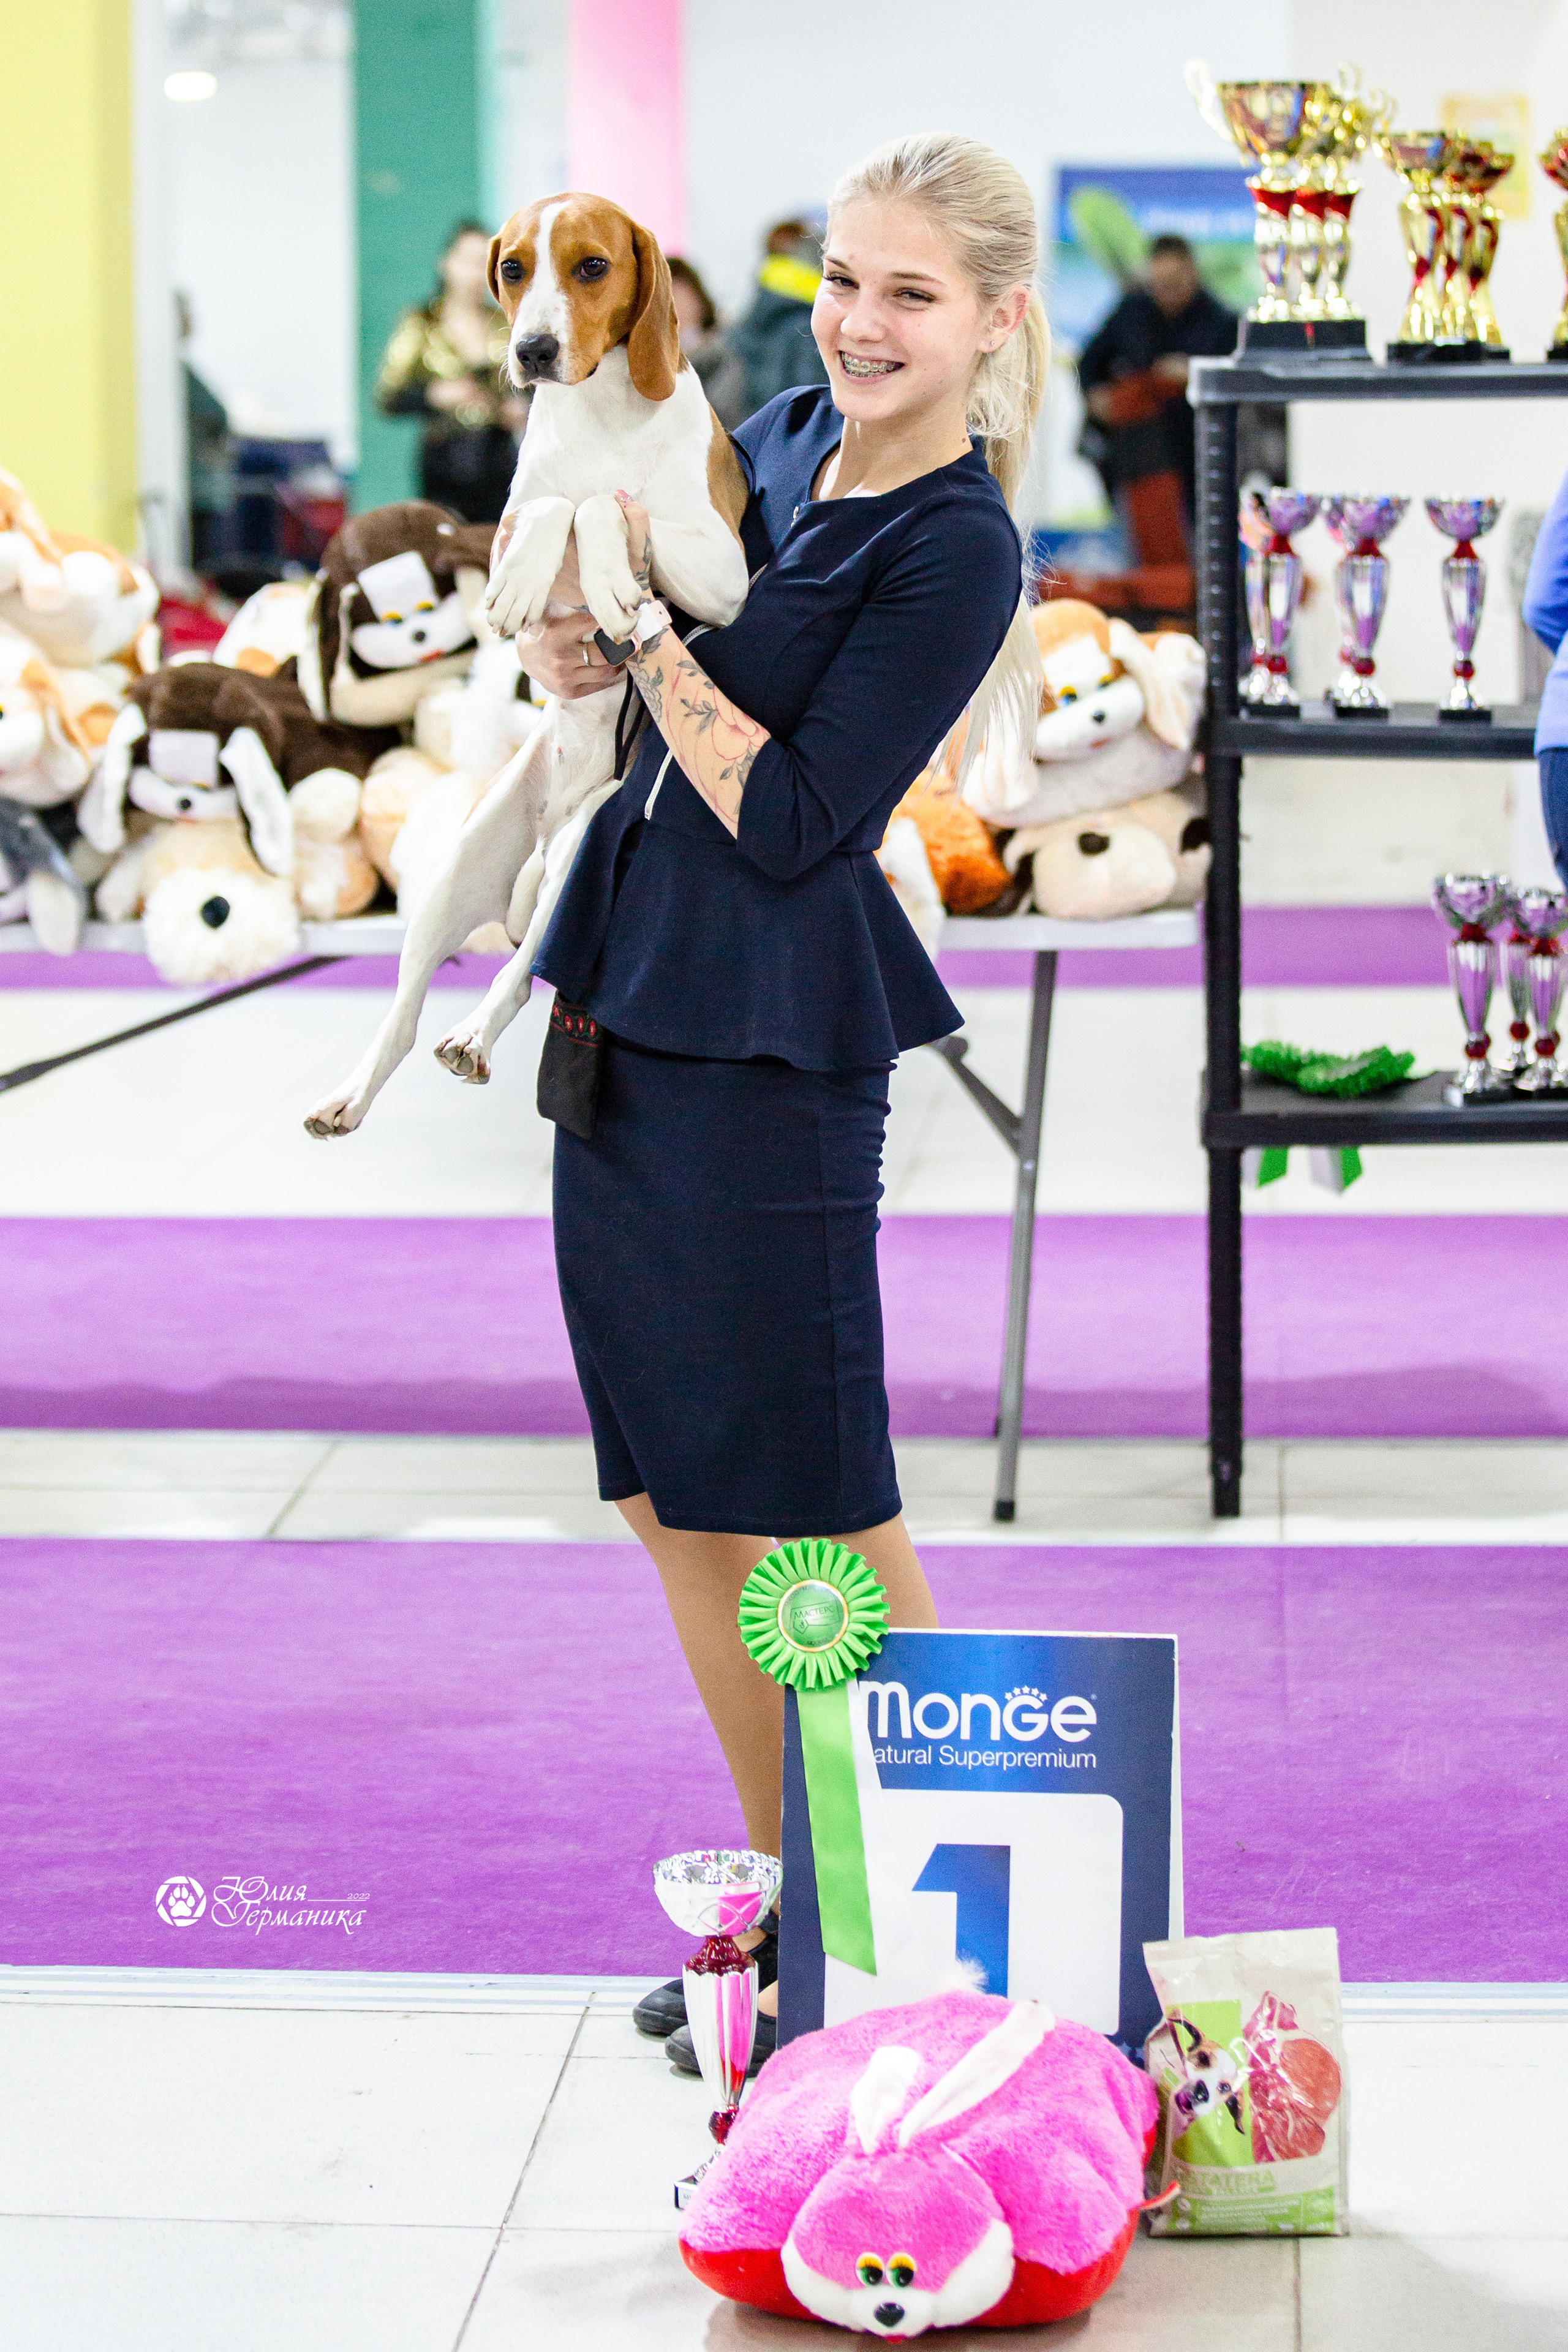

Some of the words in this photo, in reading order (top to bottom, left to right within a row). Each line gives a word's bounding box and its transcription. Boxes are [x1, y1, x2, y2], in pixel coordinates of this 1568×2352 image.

[874, 1745, 932, 1765] atural
[938, 1745, 1097, 1771] Superpremium
[911, 1843, 1011, 1999] 1
